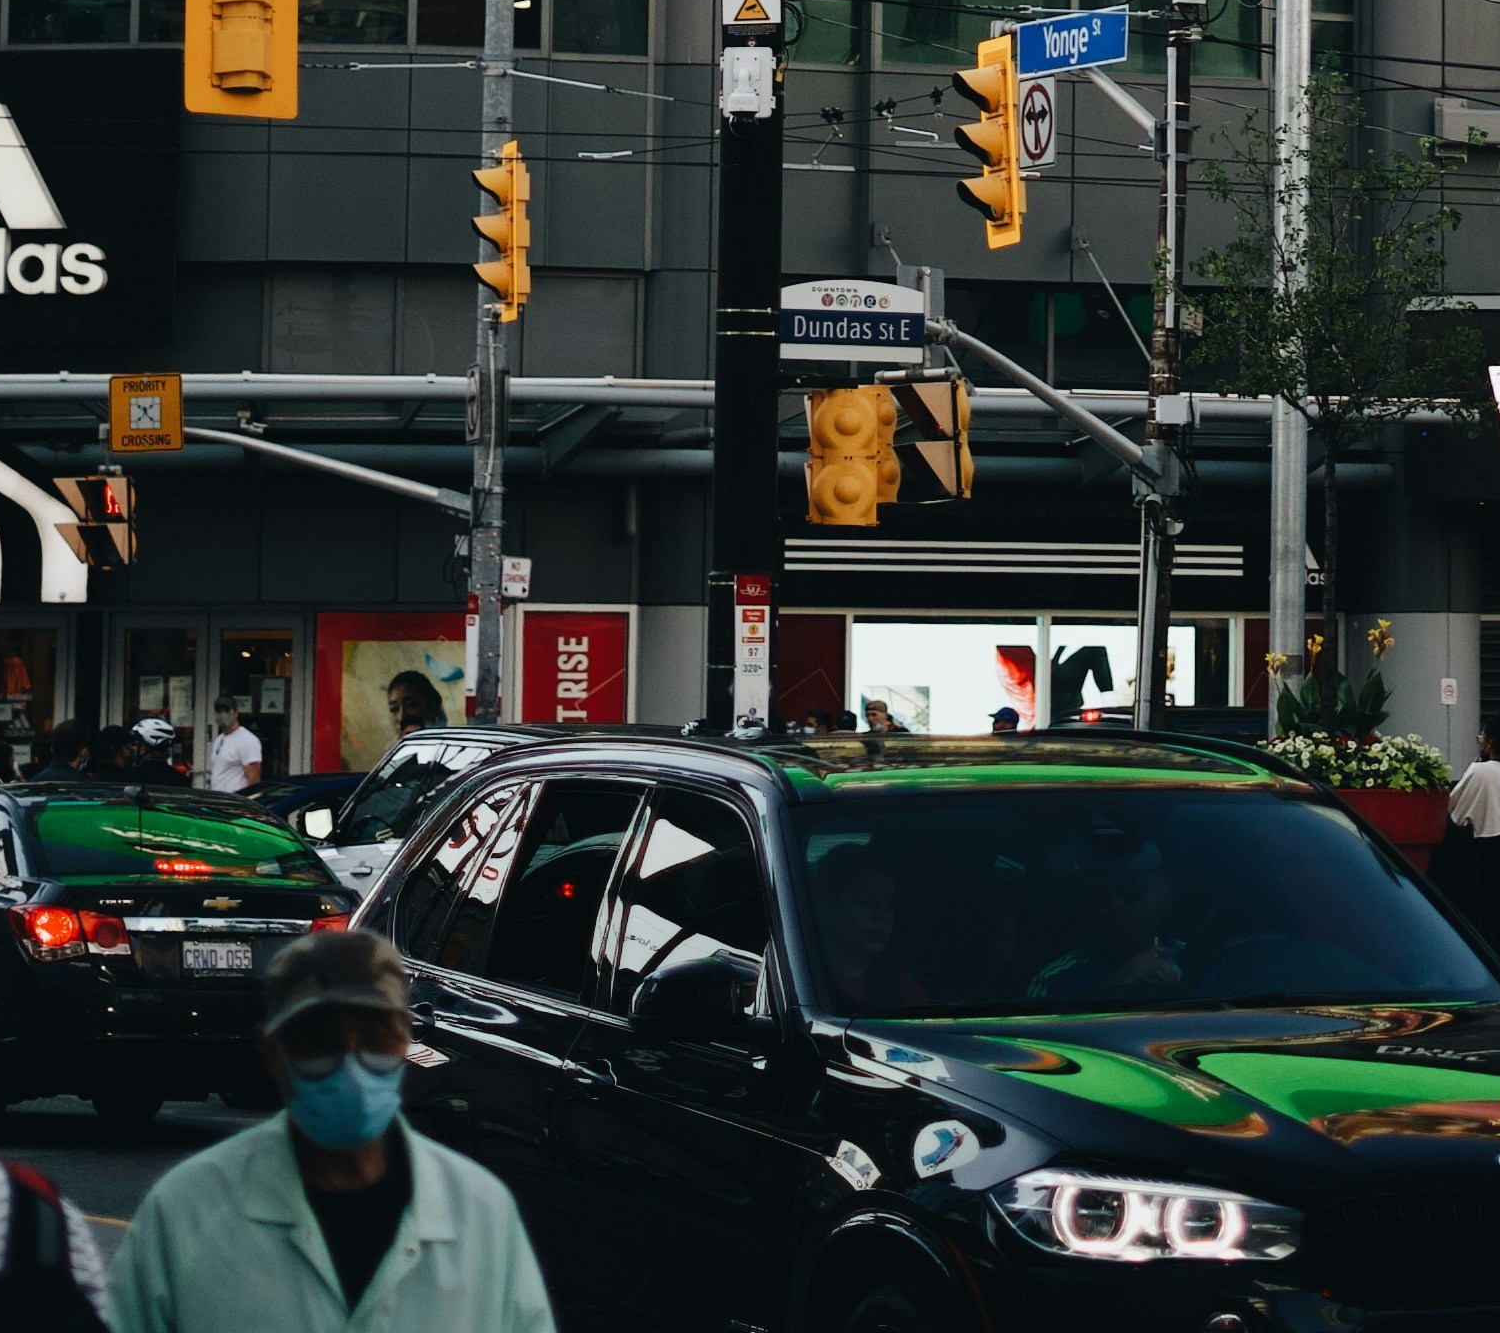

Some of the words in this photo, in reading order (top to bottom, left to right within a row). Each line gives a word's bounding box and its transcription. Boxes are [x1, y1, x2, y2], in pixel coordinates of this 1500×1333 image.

[1042, 23, 1090, 65] Yonge
[1092, 15, 1102, 36] St
[794, 313, 873, 341] Dundas
[879, 322, 895, 341] St
[900, 318, 911, 341] E
[122, 379, 167, 394] PRIORITY
[121, 433, 172, 448] CROSSING
[748, 647, 760, 658] 97
[556, 636, 589, 699] RISE
[184, 948, 219, 969] CRWD
[226, 948, 252, 969] 055
